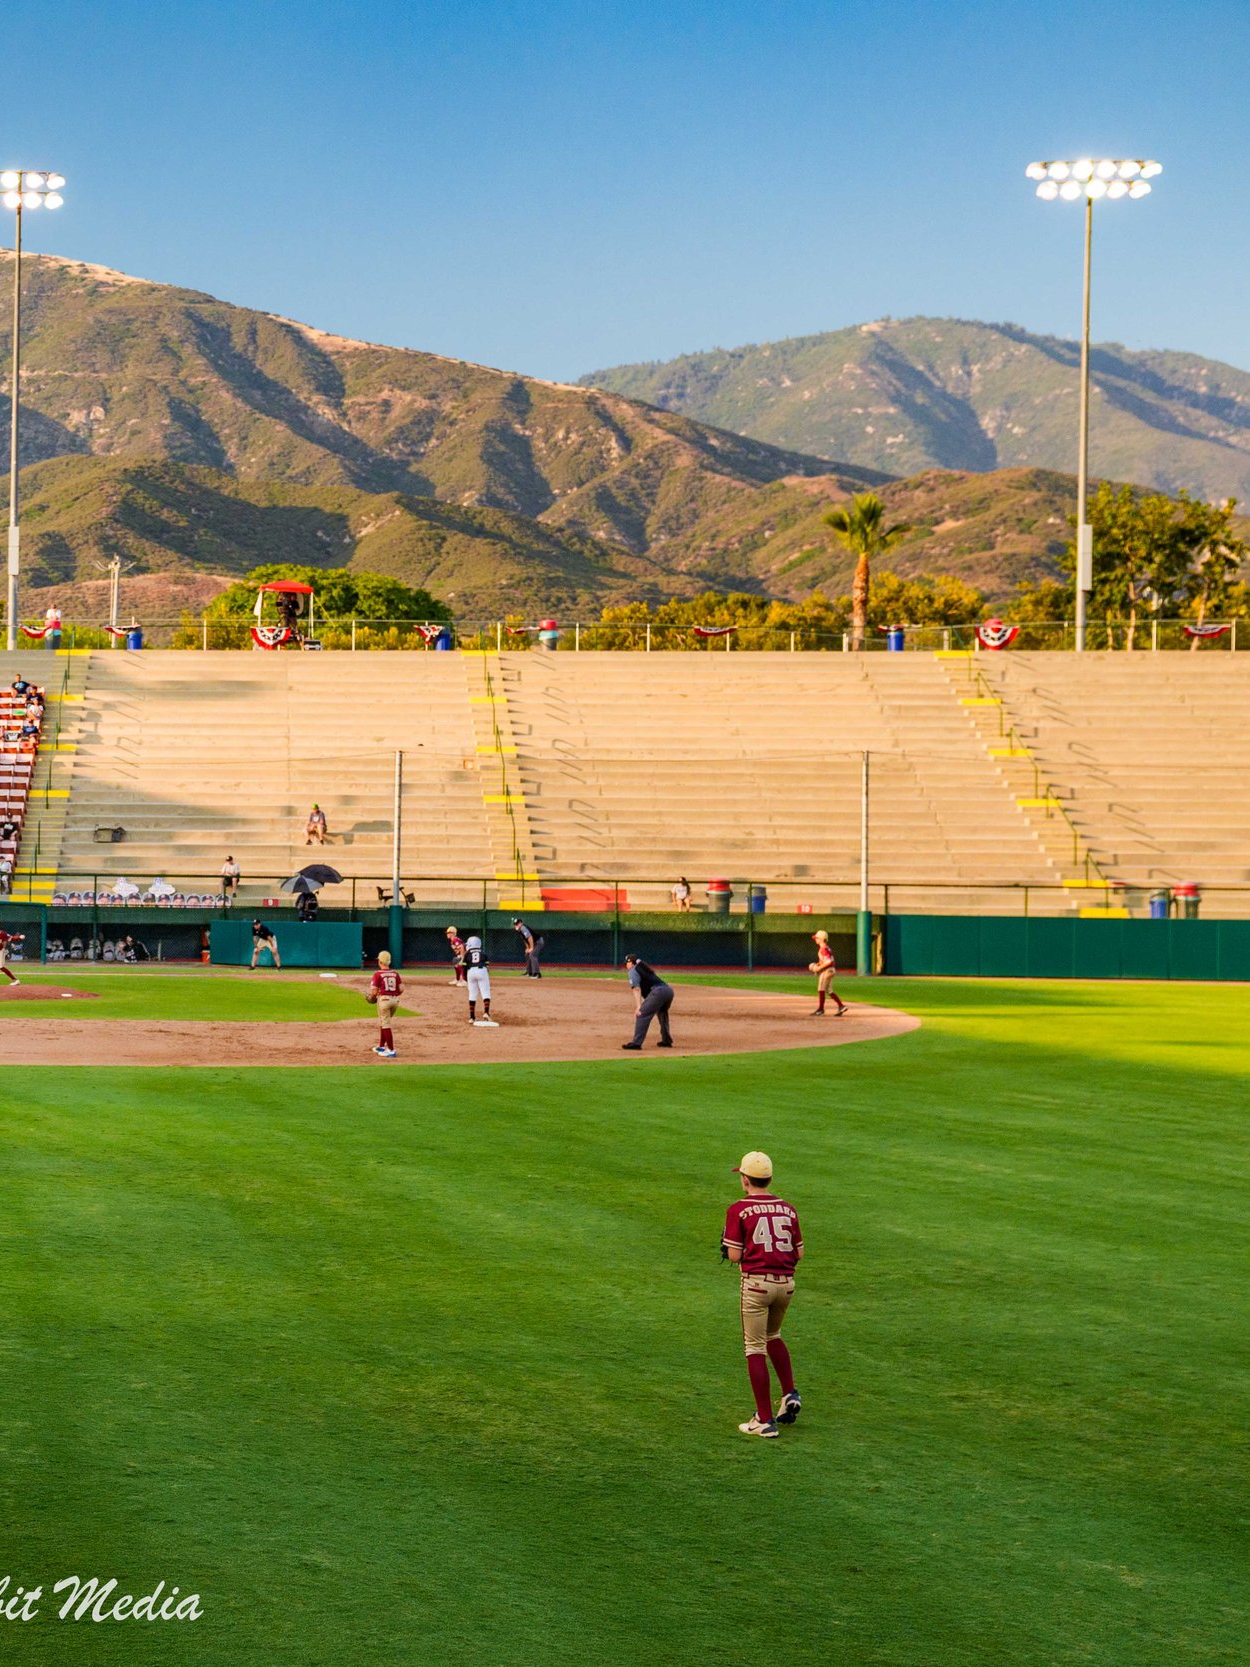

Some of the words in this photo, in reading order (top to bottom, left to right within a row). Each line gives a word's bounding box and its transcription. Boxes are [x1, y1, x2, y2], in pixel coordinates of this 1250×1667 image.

[383, 976, 397, 992] 19
[739, 1204, 797, 1220] STODDARD
[752, 1216, 794, 1253] 45
